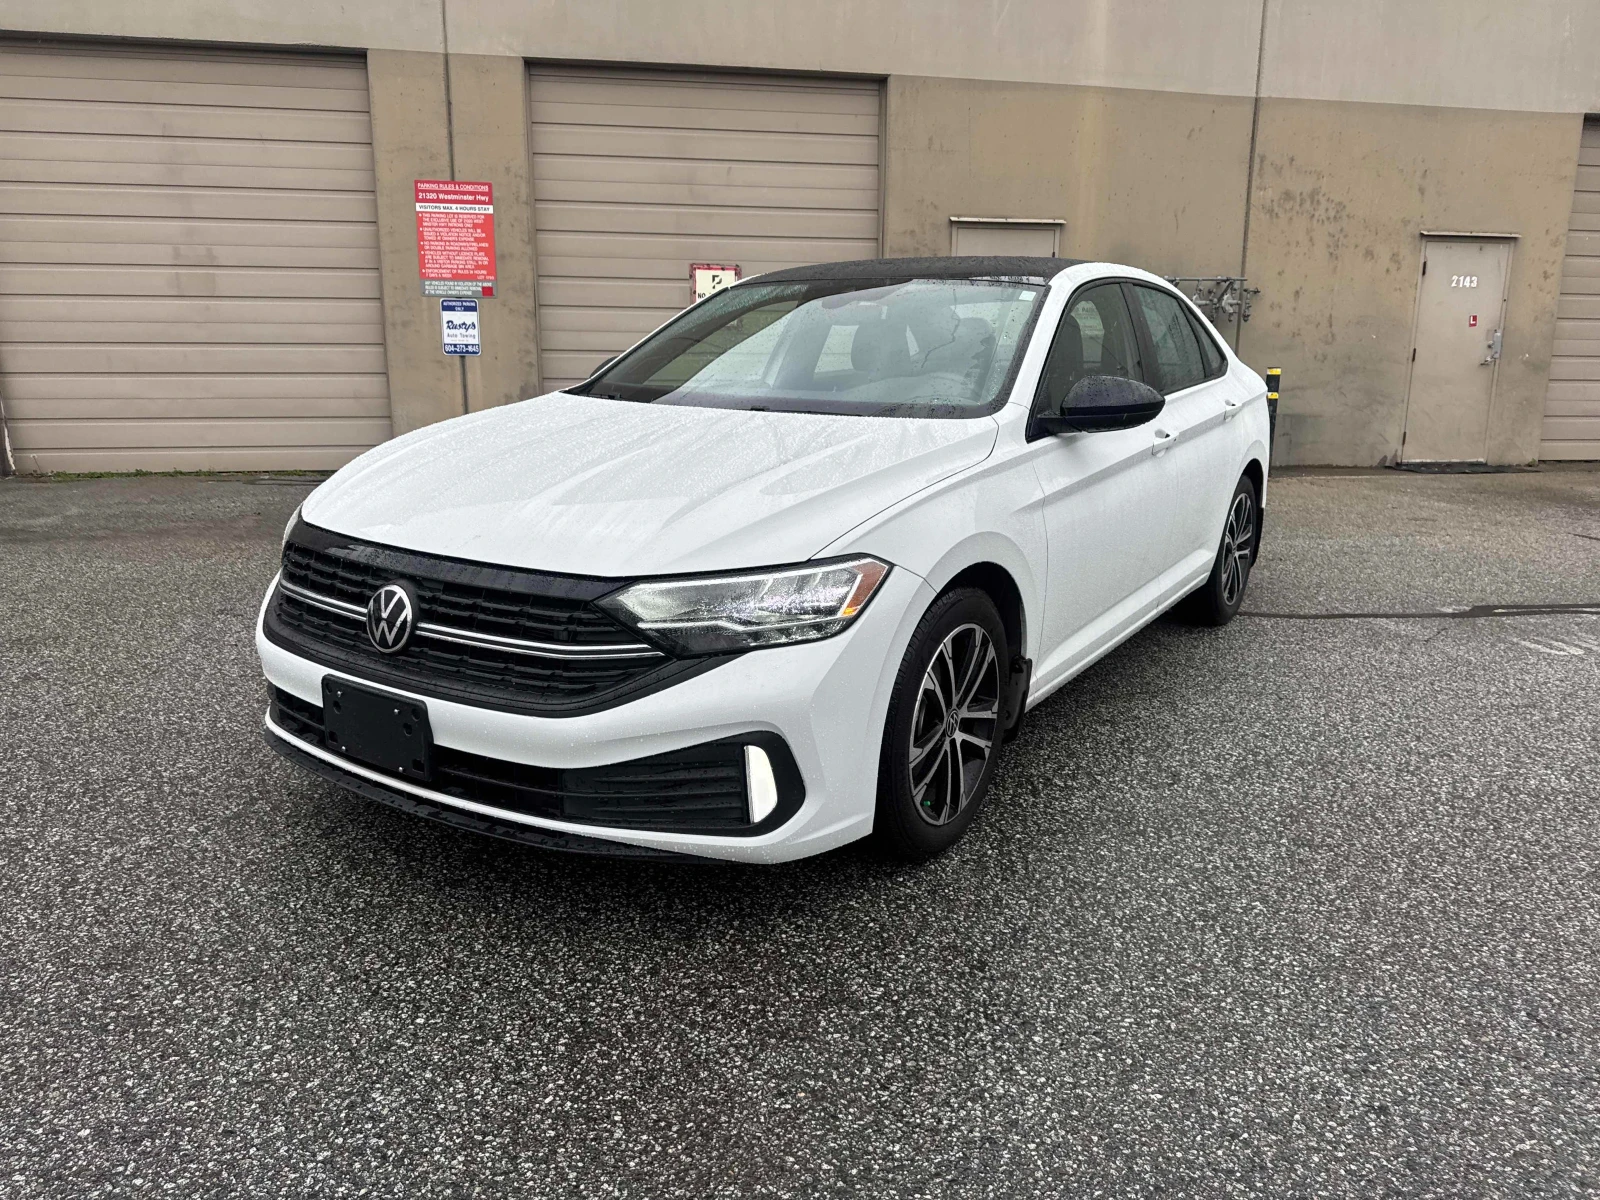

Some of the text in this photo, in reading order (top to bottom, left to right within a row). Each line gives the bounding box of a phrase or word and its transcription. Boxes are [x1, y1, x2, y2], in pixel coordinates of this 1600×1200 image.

[1451, 275, 1478, 288] 2143
[446, 320, 476, 332] Rusty's
[369, 587, 410, 650] VW
